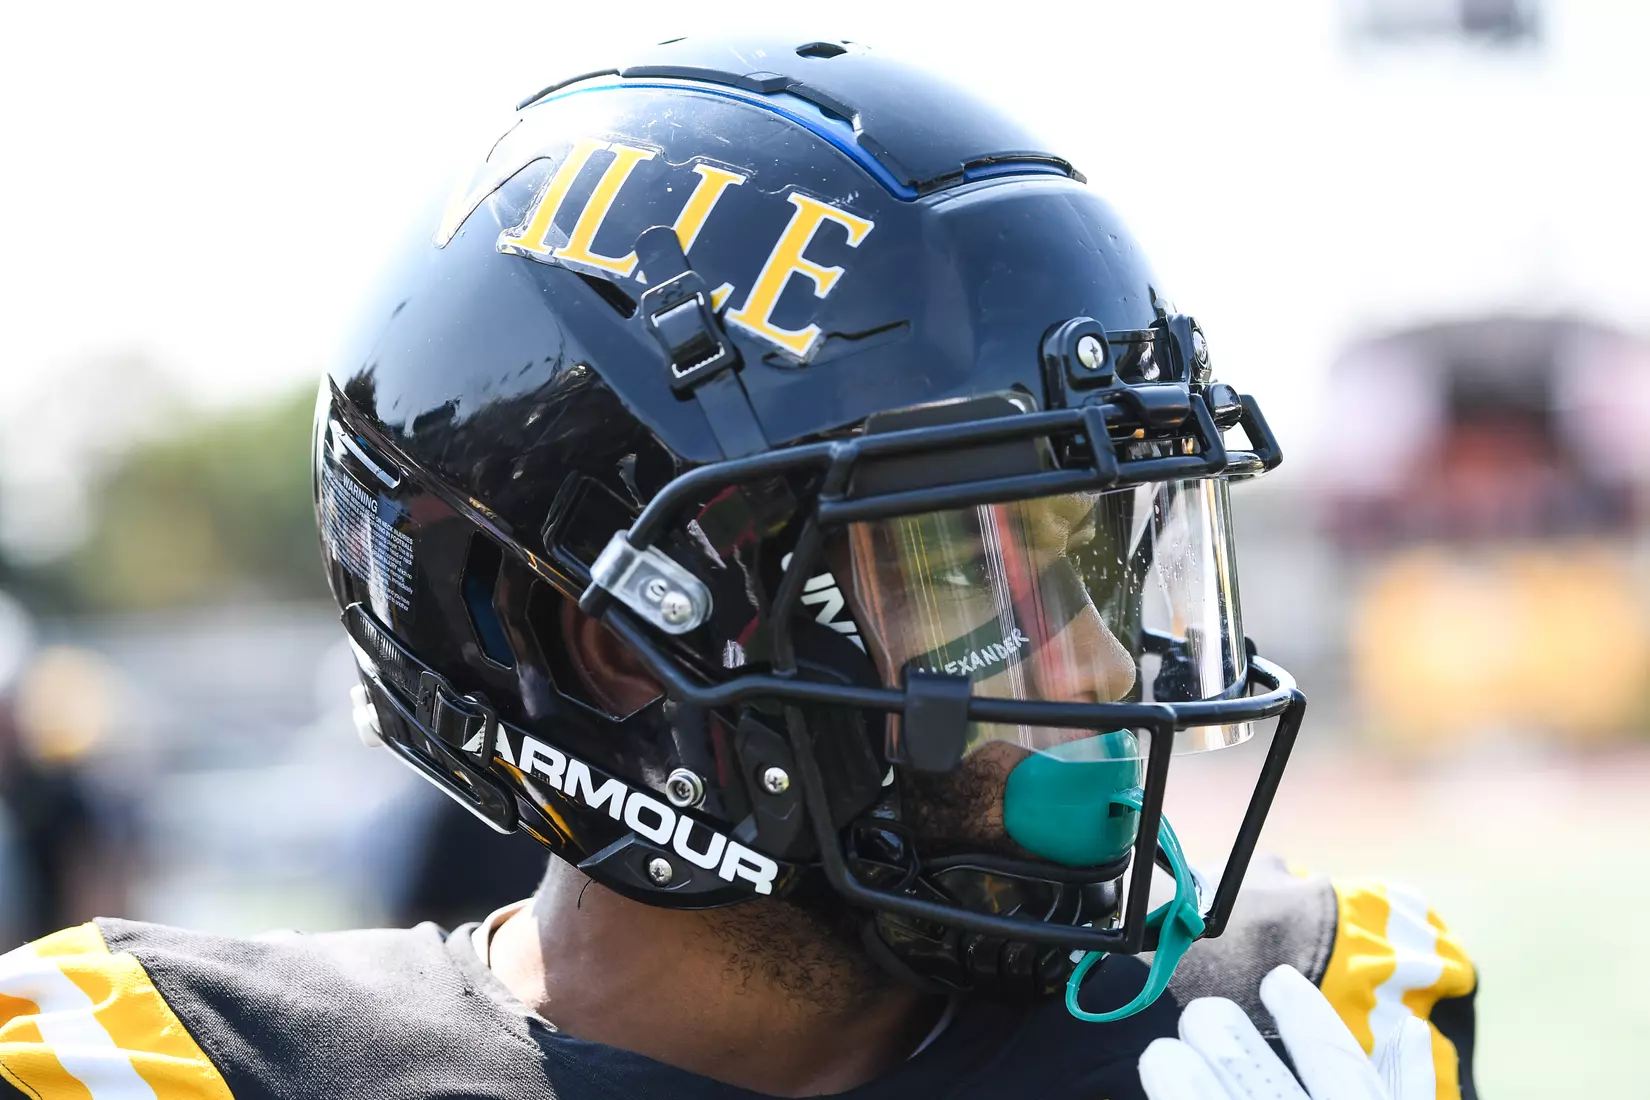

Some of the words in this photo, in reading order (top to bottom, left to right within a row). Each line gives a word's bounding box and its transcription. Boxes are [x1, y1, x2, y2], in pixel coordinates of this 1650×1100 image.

[343, 473, 378, 514] WARNING
[382, 520, 393, 533] NECK
[393, 528, 413, 545] INJURIES
[919, 628, 1029, 675] EXANDER
[461, 722, 779, 895] ARMOUR
